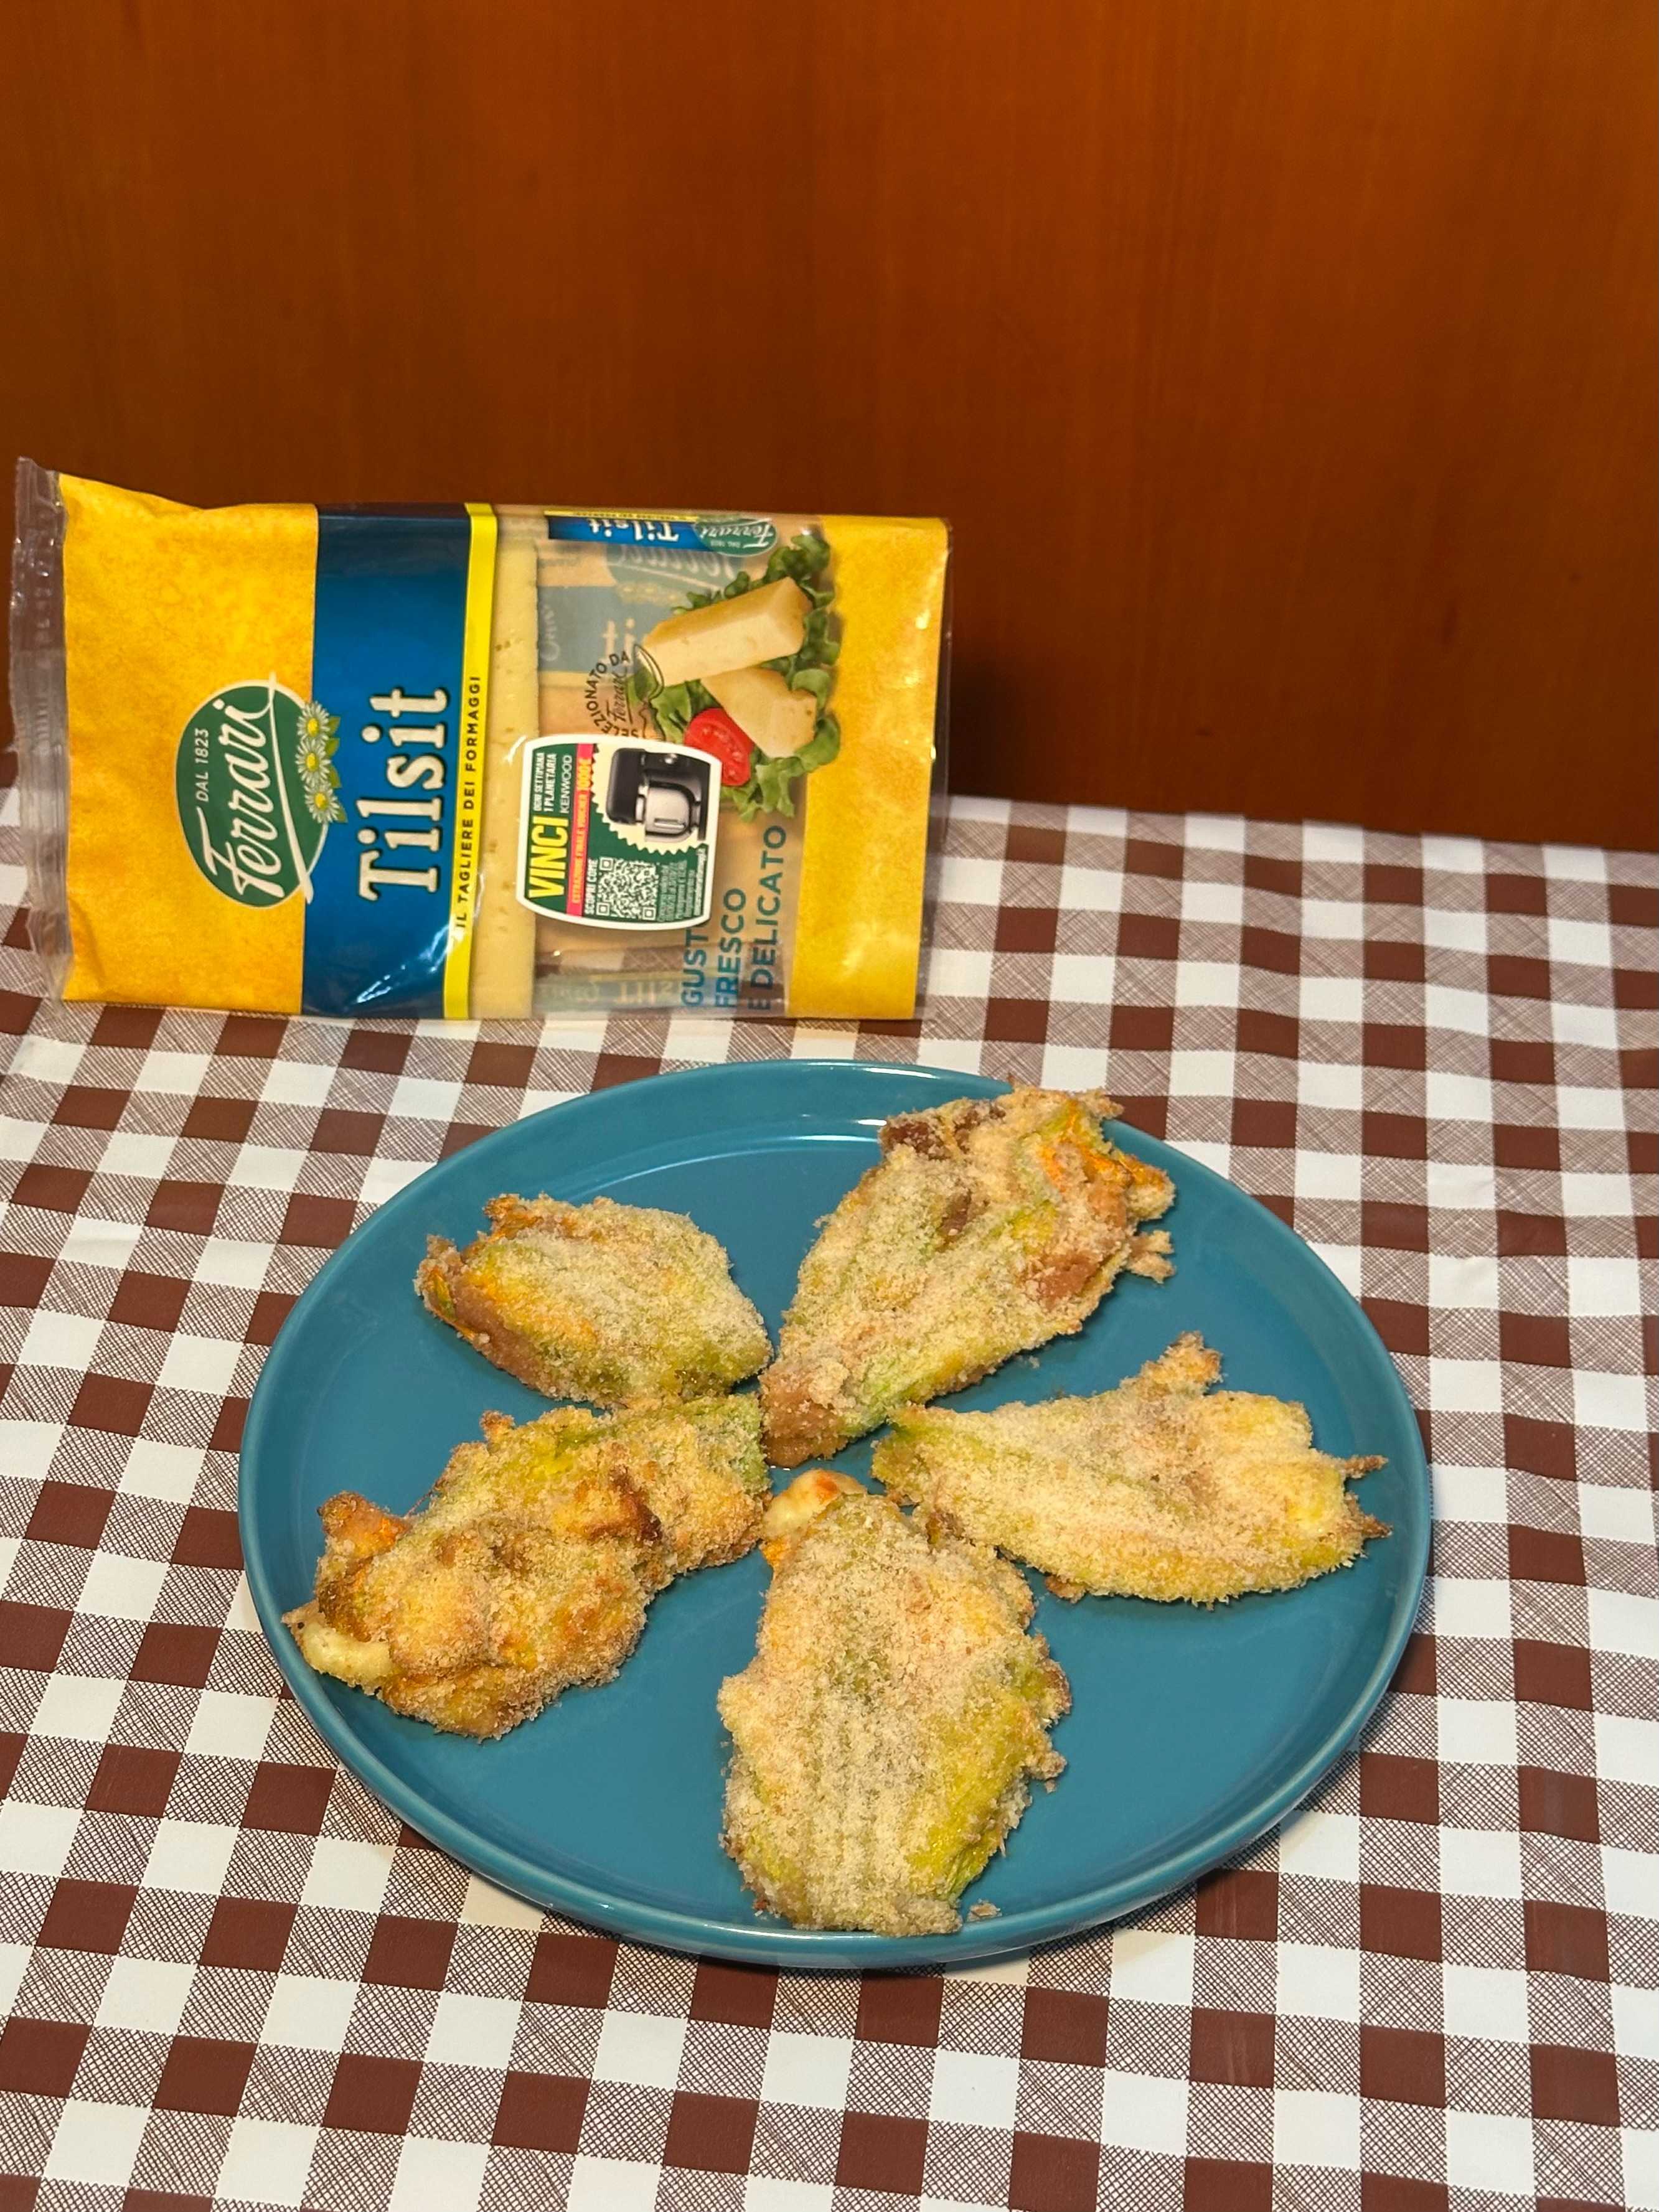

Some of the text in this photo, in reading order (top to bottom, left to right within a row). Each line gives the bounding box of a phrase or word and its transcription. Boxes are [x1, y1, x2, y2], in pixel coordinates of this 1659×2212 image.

[609, 650, 630, 667] DA
[195, 728, 210, 802] DAL 1823
[197, 671, 314, 904] Ferrari
[355, 687, 449, 901] Tilsit
[456, 676, 481, 928] IL TAGLIERE DEI FORMAGGI
[534, 752, 545, 793] SETTIMANA
[543, 754, 557, 807] PLANETARIA
[560, 755, 572, 813] KENWOOD
[529, 816, 569, 898] VINCI
[585, 858, 598, 914] SCOPRI COME
[715, 888, 746, 1008] FRESCO
[748, 825, 786, 1010] E DELICATO
[681, 926, 709, 1007] GUST
